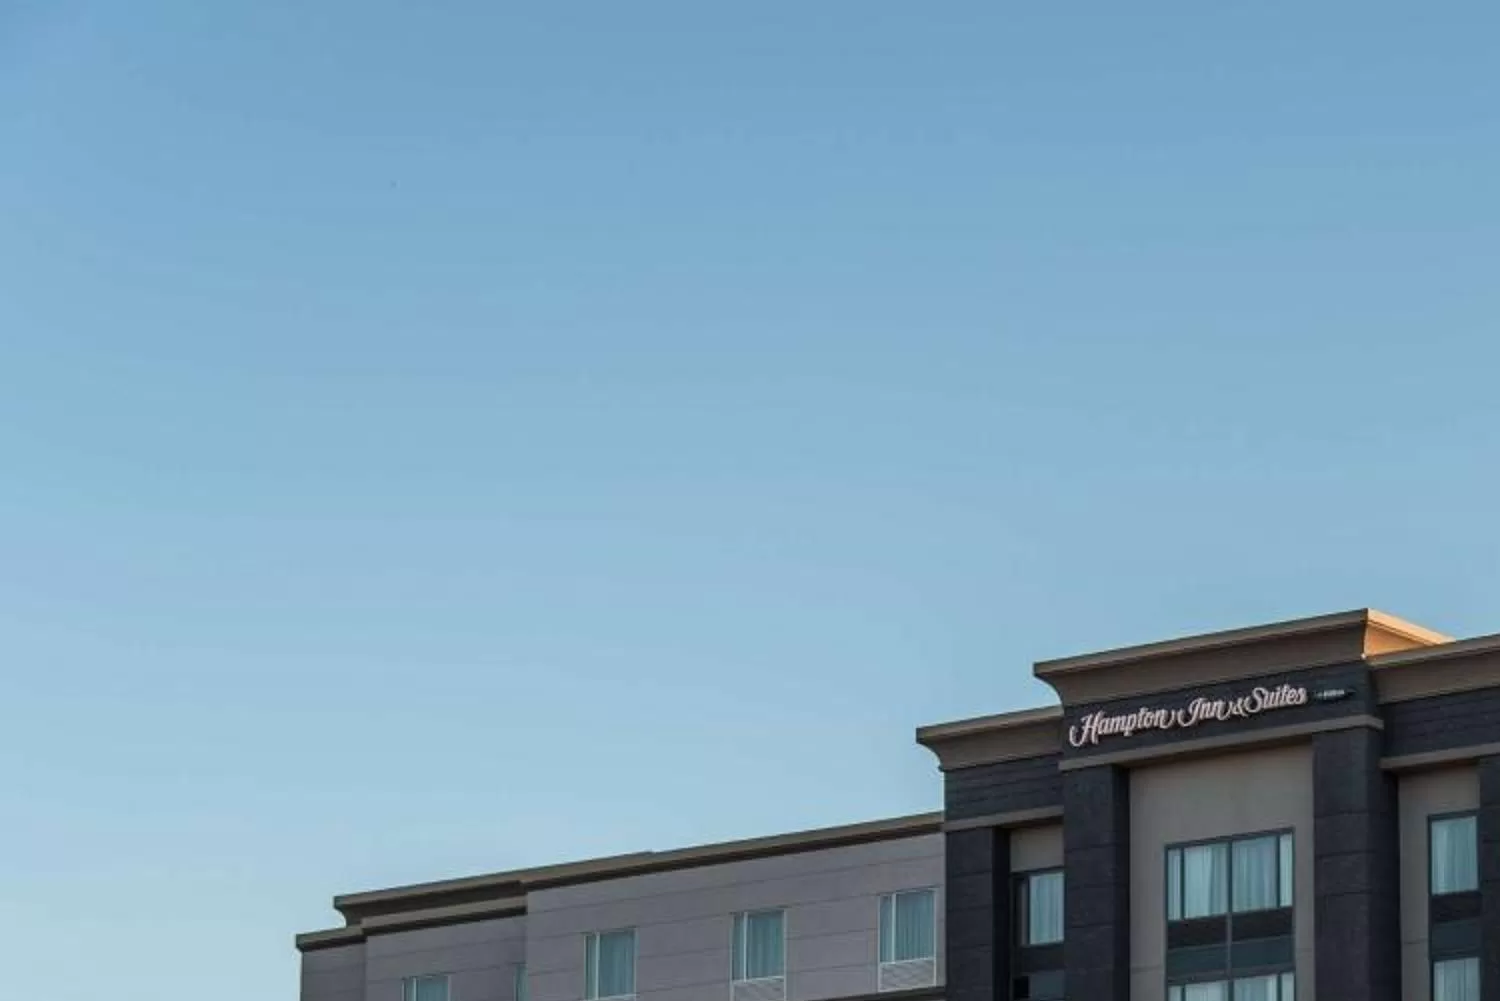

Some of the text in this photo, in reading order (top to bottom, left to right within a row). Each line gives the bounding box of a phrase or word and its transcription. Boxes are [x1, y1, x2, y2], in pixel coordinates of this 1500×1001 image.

[1069, 708, 1174, 747] Hampton
[1178, 697, 1233, 727] Inn
[1246, 684, 1308, 713] Suites
